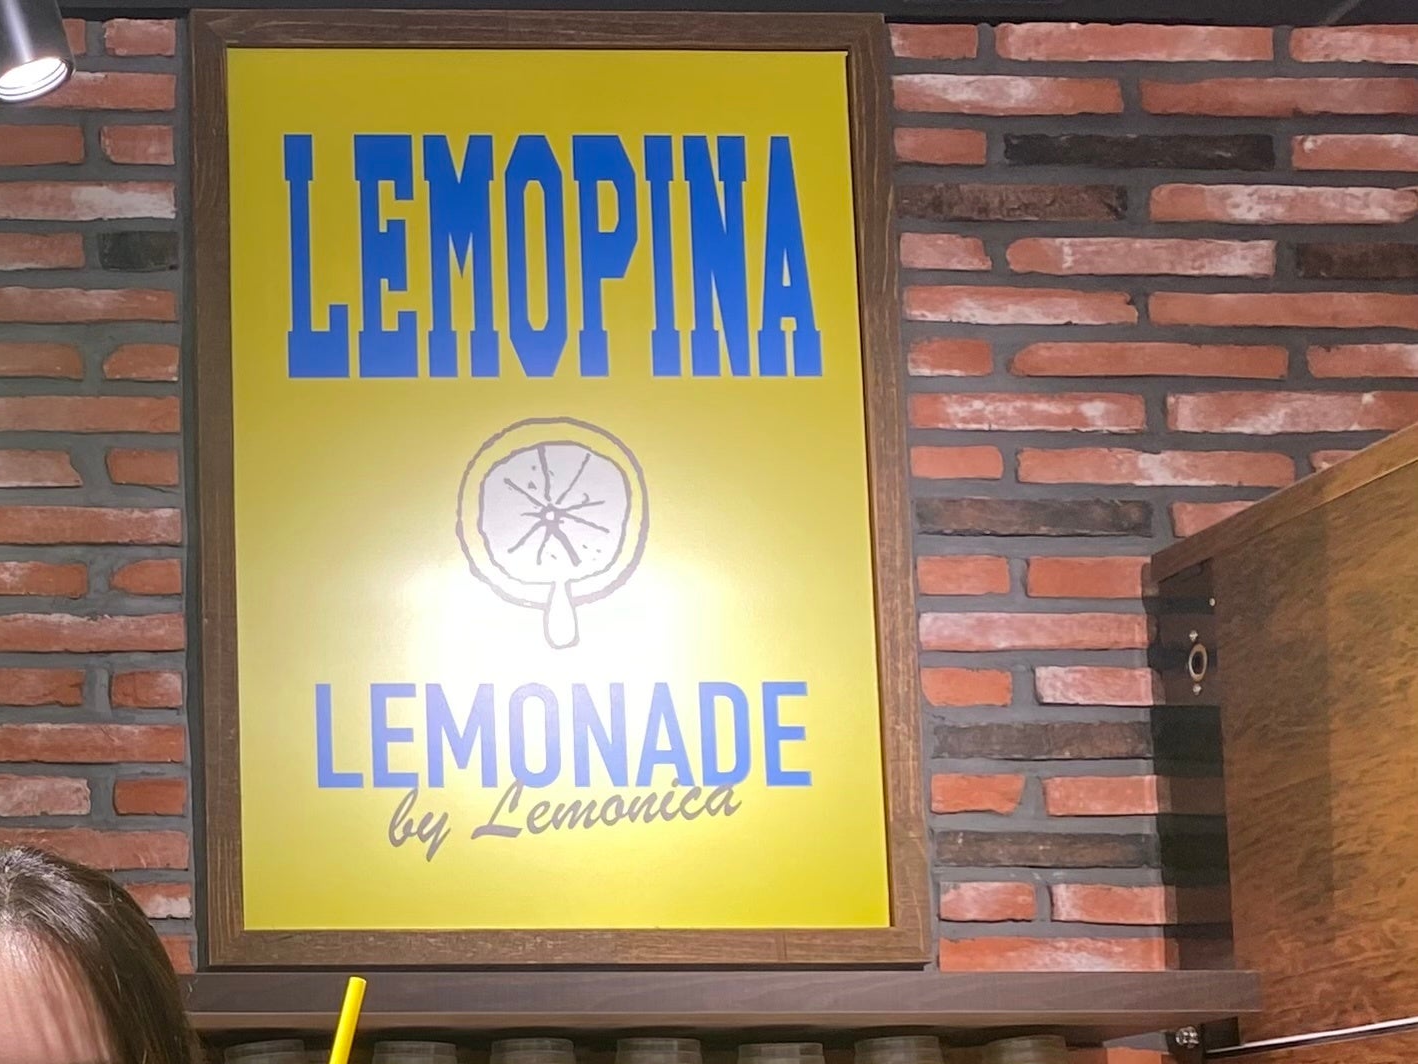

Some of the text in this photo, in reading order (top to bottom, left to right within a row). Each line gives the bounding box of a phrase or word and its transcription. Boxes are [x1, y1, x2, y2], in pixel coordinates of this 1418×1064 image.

[283, 133, 823, 378] LEMOPINA
[315, 681, 813, 789] LEMONADE
[387, 778, 742, 862] by Lemonica
